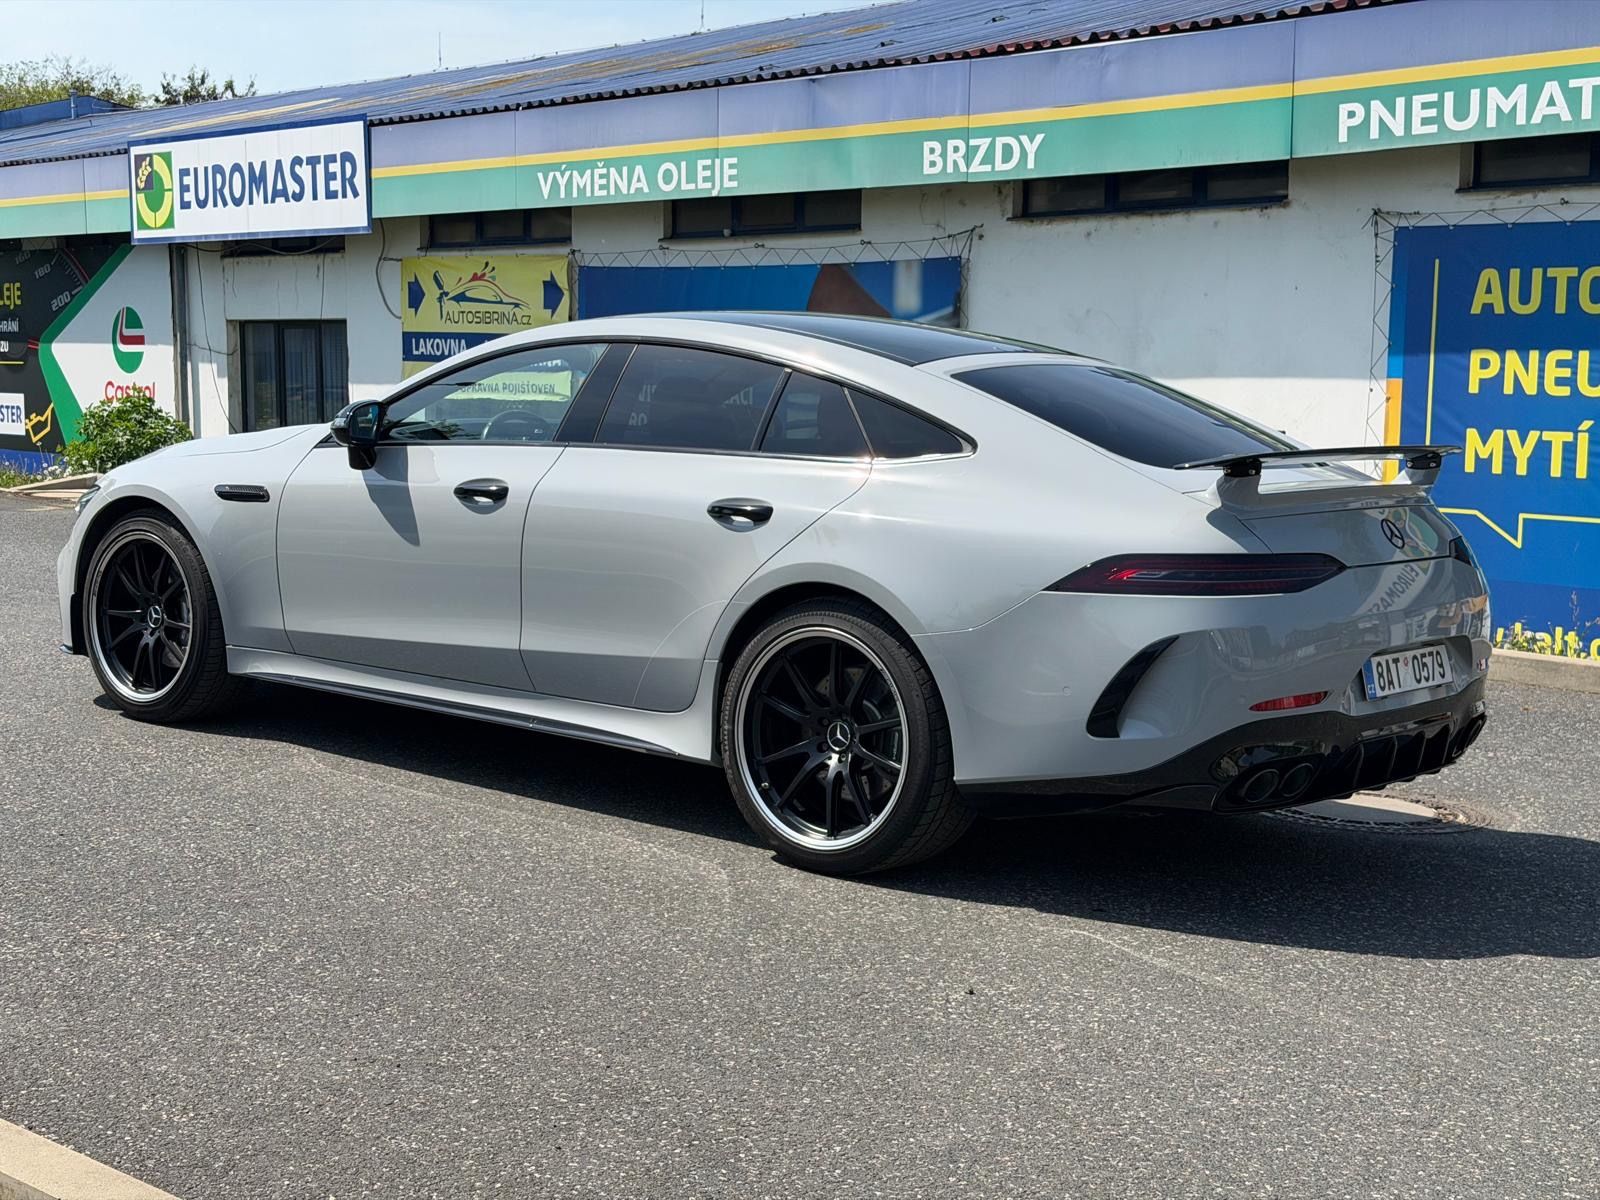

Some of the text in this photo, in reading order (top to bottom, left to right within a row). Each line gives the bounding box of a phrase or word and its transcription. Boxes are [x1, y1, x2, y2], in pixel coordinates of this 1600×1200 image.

[1338, 77, 1600, 143] PNEUMAT
[923, 133, 1045, 175] BRZDY
[178, 151, 360, 210] EUROMASTER
[537, 157, 738, 199] VÝMĚNA OLEJE
[34, 263, 51, 279] 180
[1470, 266, 1600, 315] AUTO
[50, 291, 71, 312] 200
[412, 337, 468, 356] LAKOVNA
[1467, 349, 1600, 398] PNEU
[1464, 420, 1595, 479] MYTÍ
[1367, 684, 1375, 694] CZ
[1376, 650, 1446, 692] 8AT 0579
